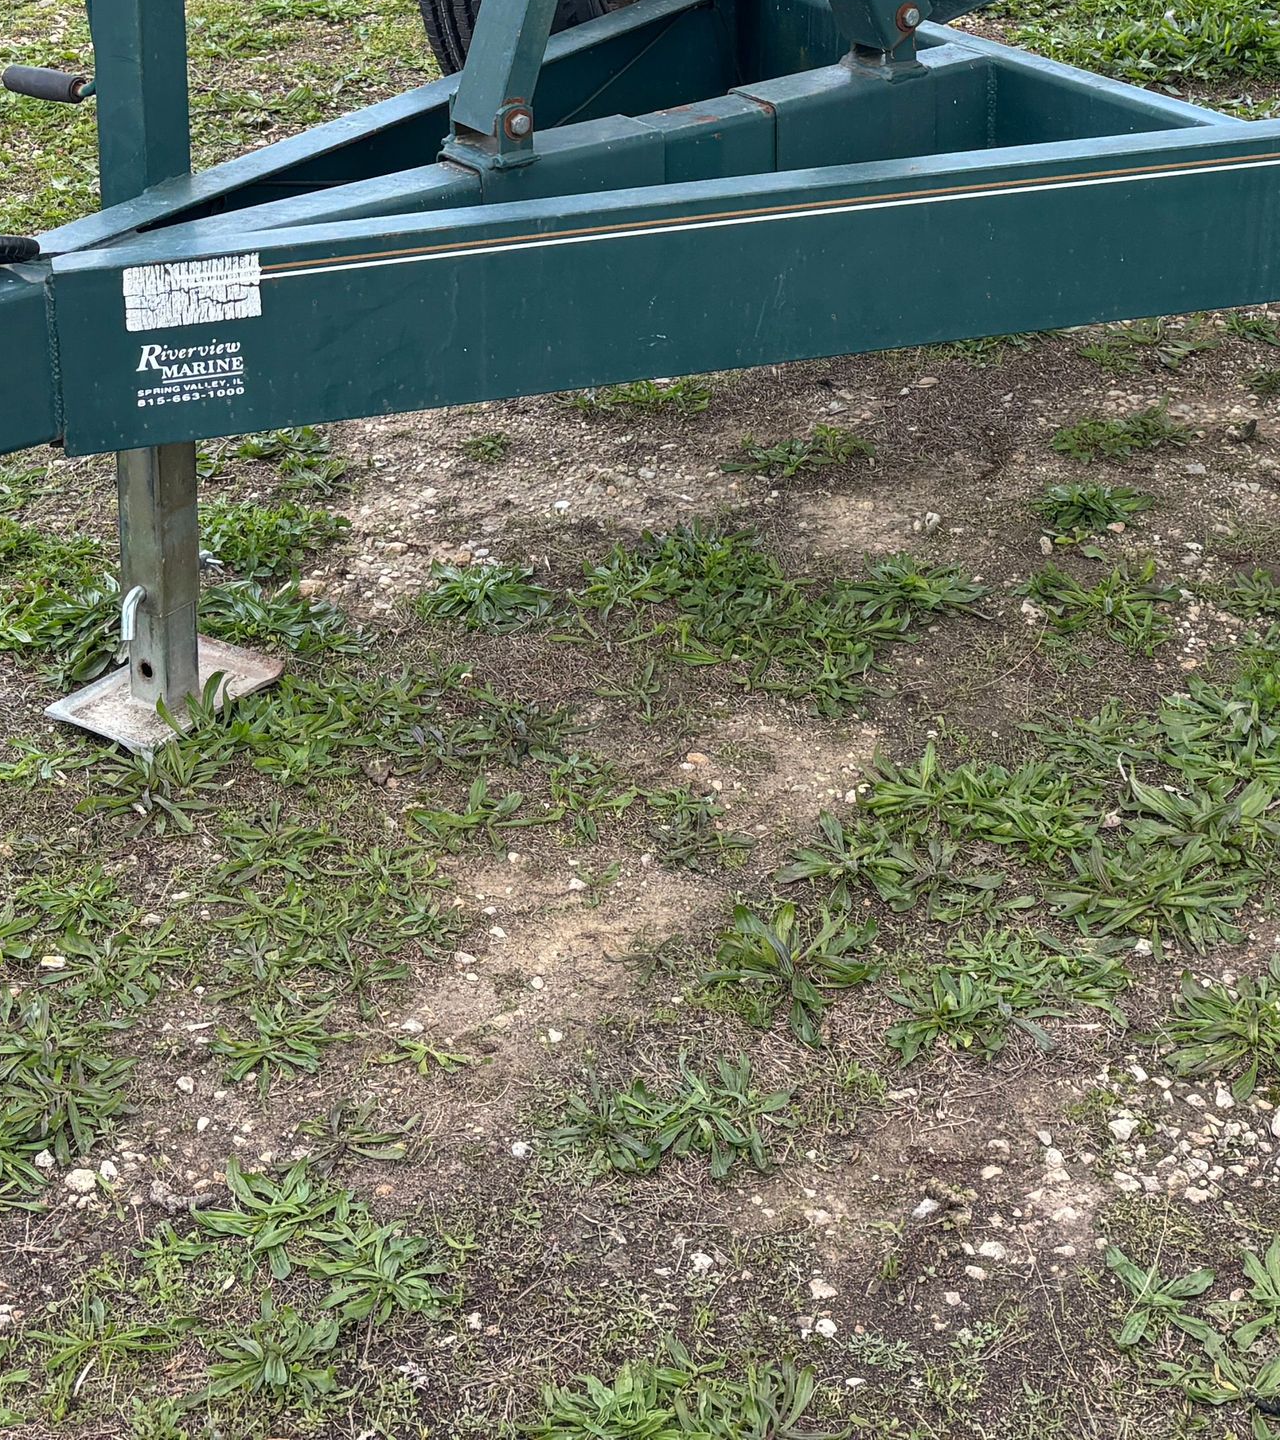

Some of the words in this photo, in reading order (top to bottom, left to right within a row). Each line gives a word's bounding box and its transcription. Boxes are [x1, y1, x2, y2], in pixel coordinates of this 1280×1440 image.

[136, 338, 241, 372] Riverview
[161, 356, 244, 379] MARINE
[137, 385, 181, 398] SPRING
[183, 380, 230, 391] VALLEY,
[233, 378, 244, 386] IL
[137, 386, 245, 408] 815-663-1000
